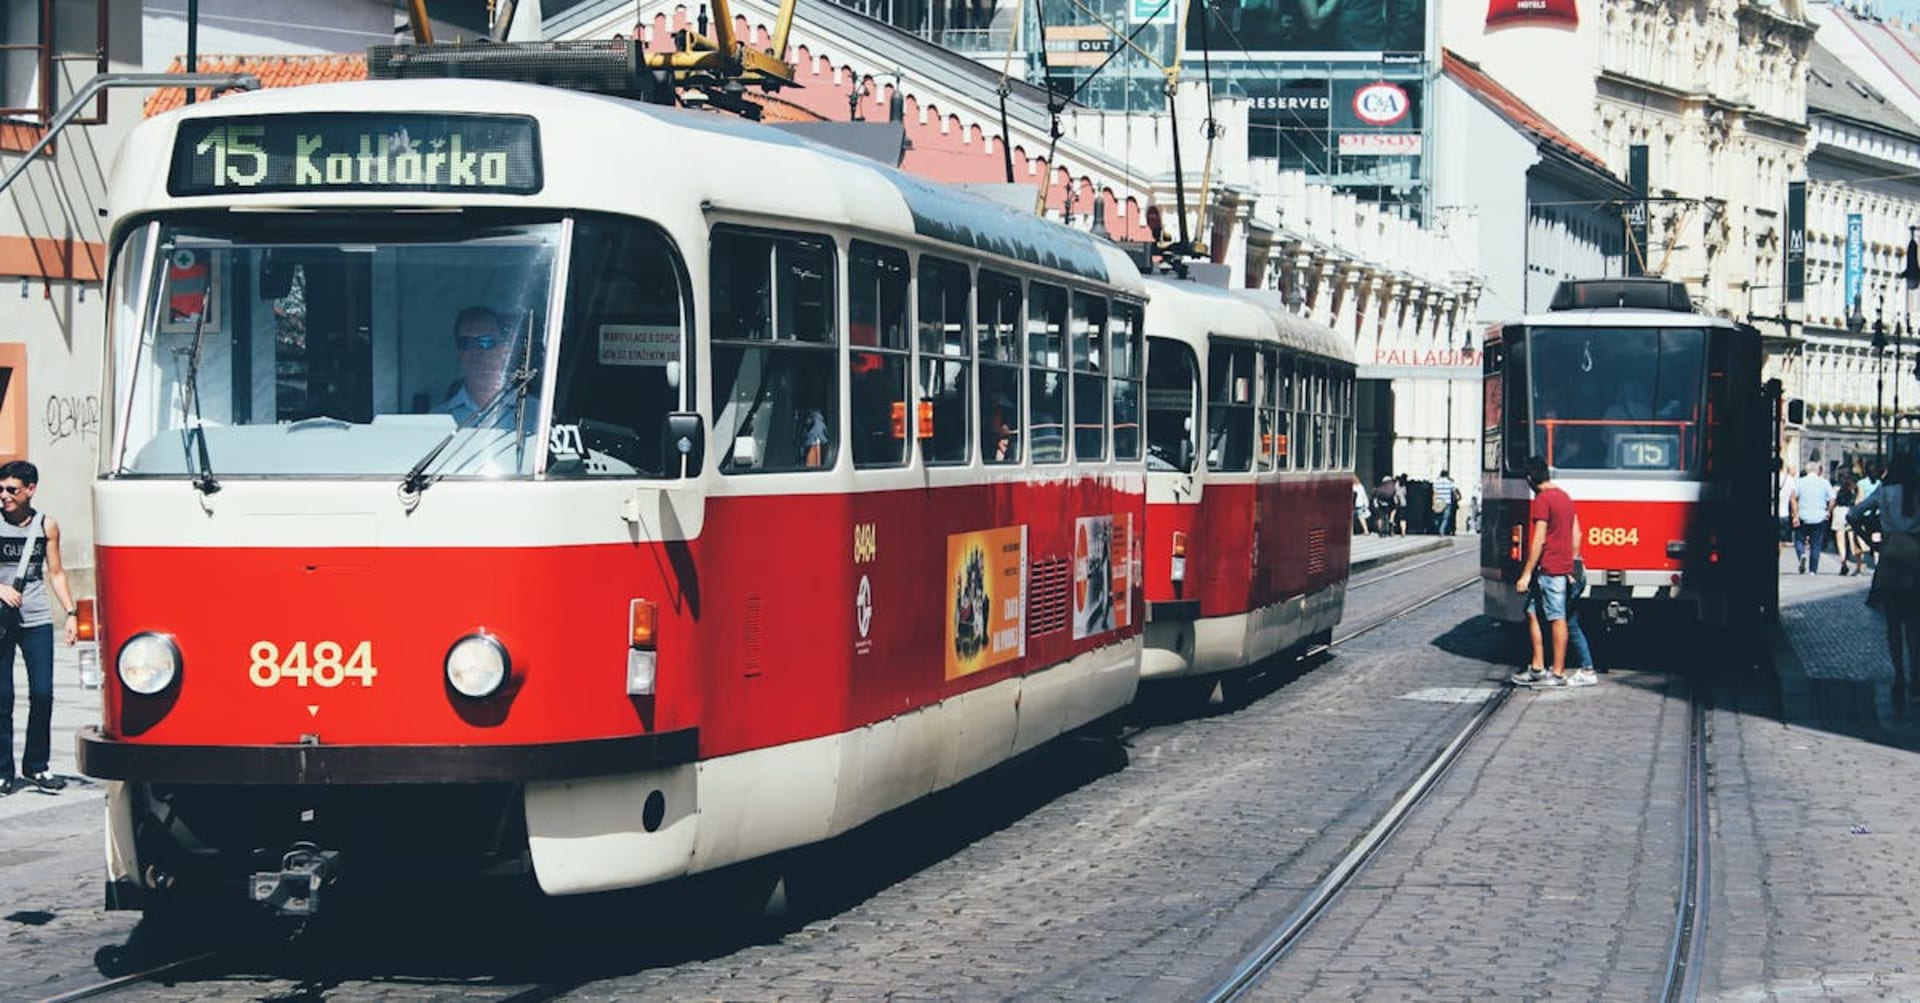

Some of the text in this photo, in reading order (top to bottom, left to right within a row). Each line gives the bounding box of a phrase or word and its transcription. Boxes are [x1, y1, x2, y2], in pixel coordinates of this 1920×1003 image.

[1080, 41, 1111, 51] OUT
[1247, 97, 1329, 109] RESERVED
[1363, 94, 1399, 113] C&A
[196, 126, 508, 186] 15 Kotlářka
[550, 424, 584, 454] 327
[1630, 441, 1663, 464] 15
[854, 522, 876, 563] 8484
[1588, 527, 1639, 547] 8684
[248, 640, 378, 688] 8484
